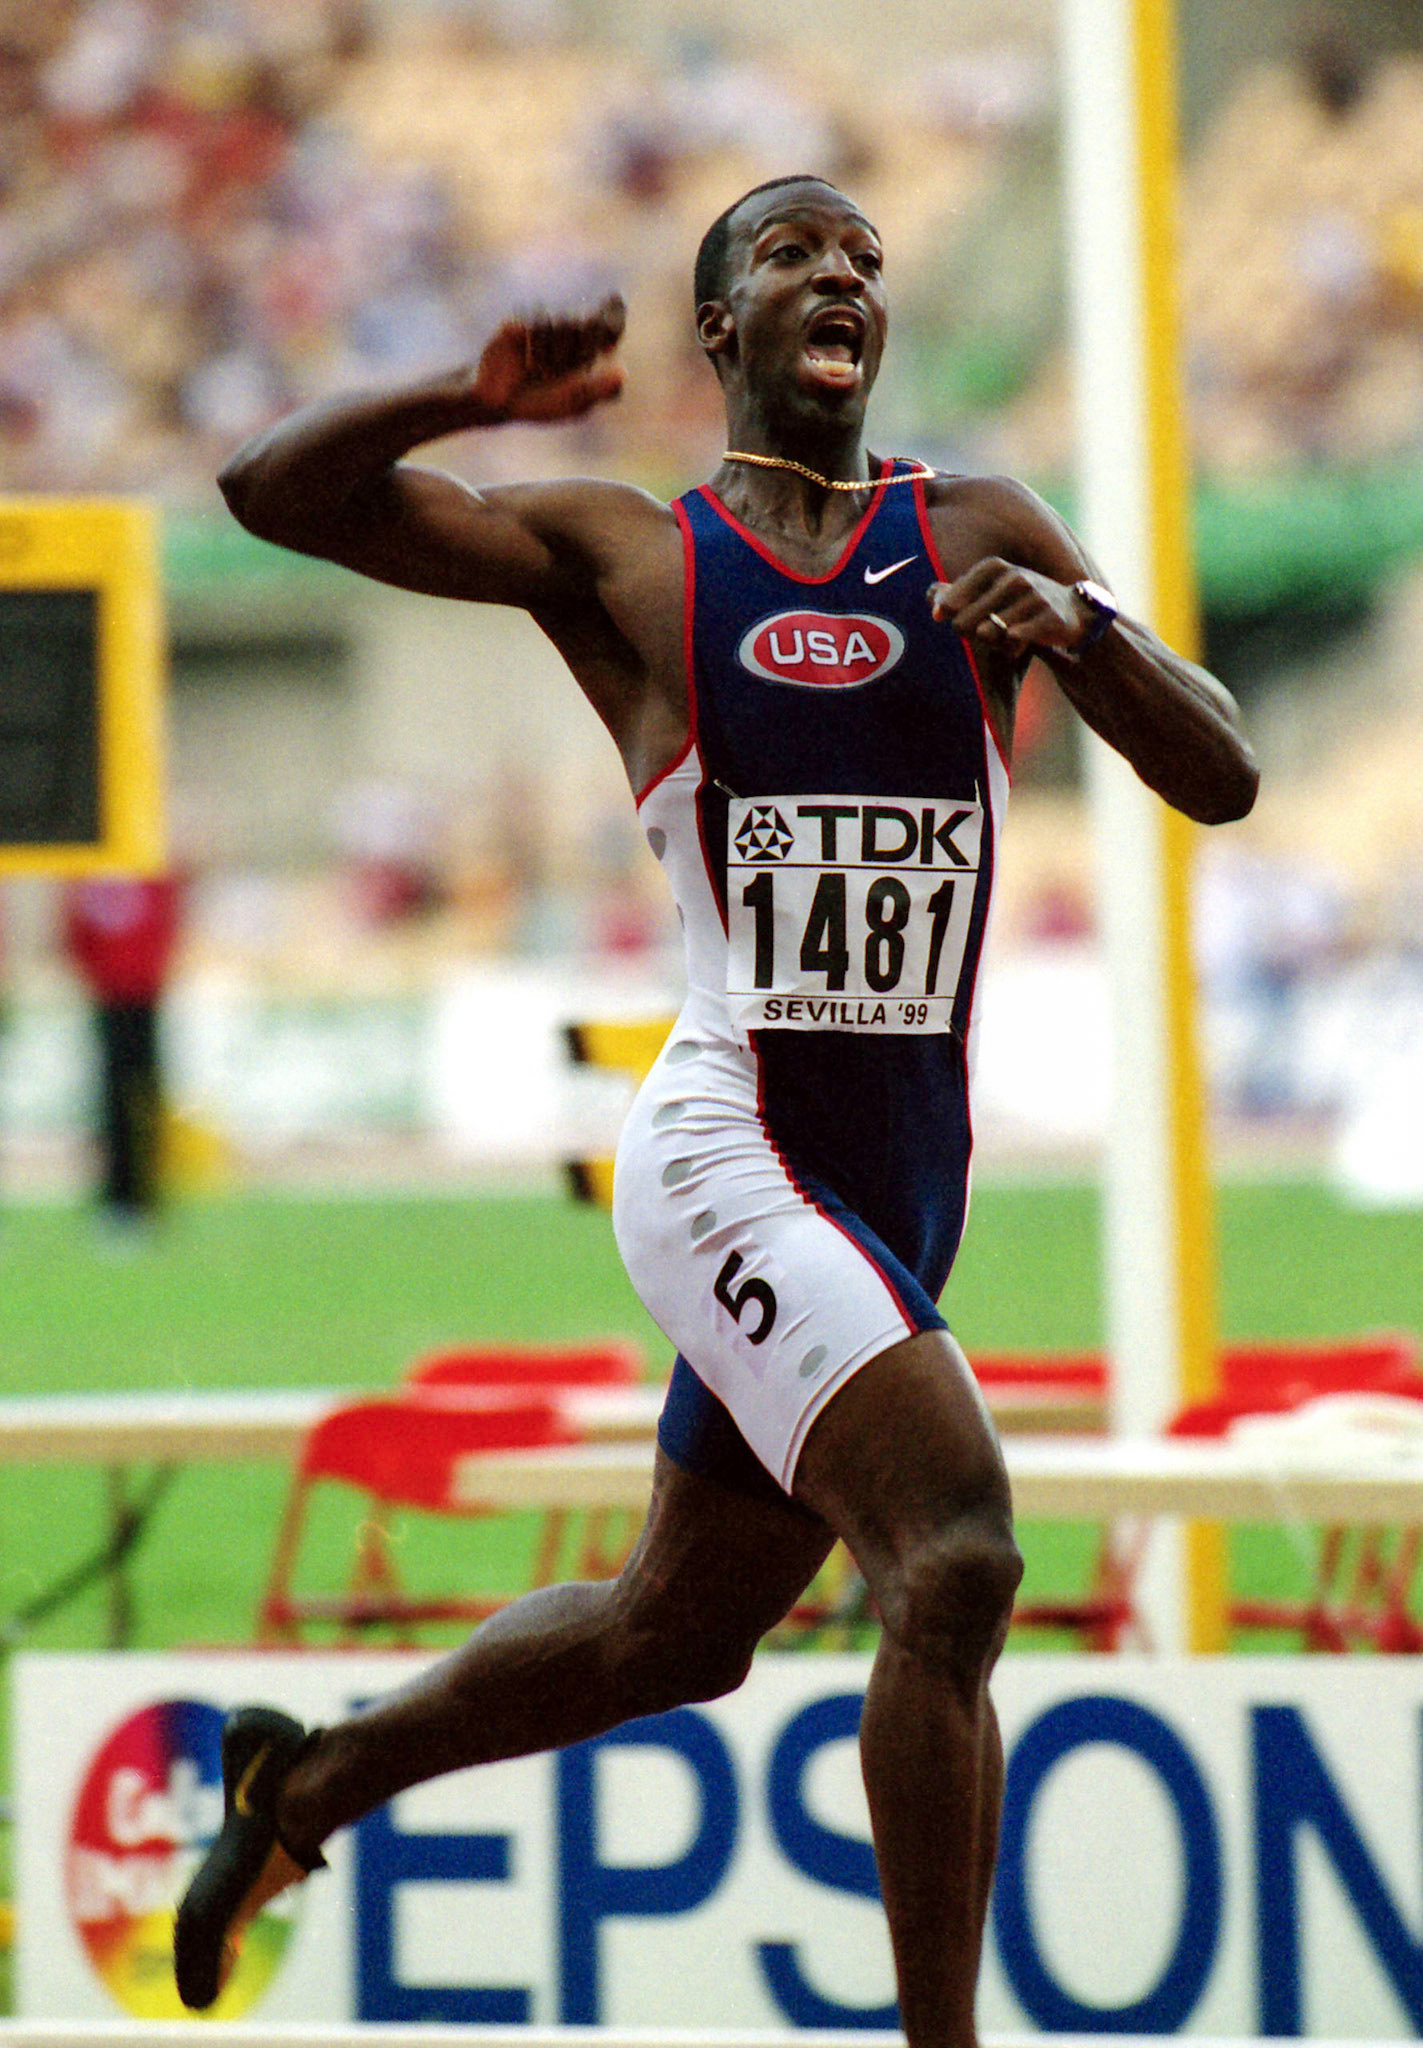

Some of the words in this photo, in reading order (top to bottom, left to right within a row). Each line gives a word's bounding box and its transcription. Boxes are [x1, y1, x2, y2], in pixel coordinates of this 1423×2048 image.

[768, 629, 877, 666] USA
[797, 805, 974, 866] TDK
[742, 871, 956, 995] 1481
[763, 999, 887, 1025] SEVILLA
[898, 1003, 928, 1025] '99
[713, 1249, 777, 1346] 5
[352, 1694, 1422, 2036] EPSON
